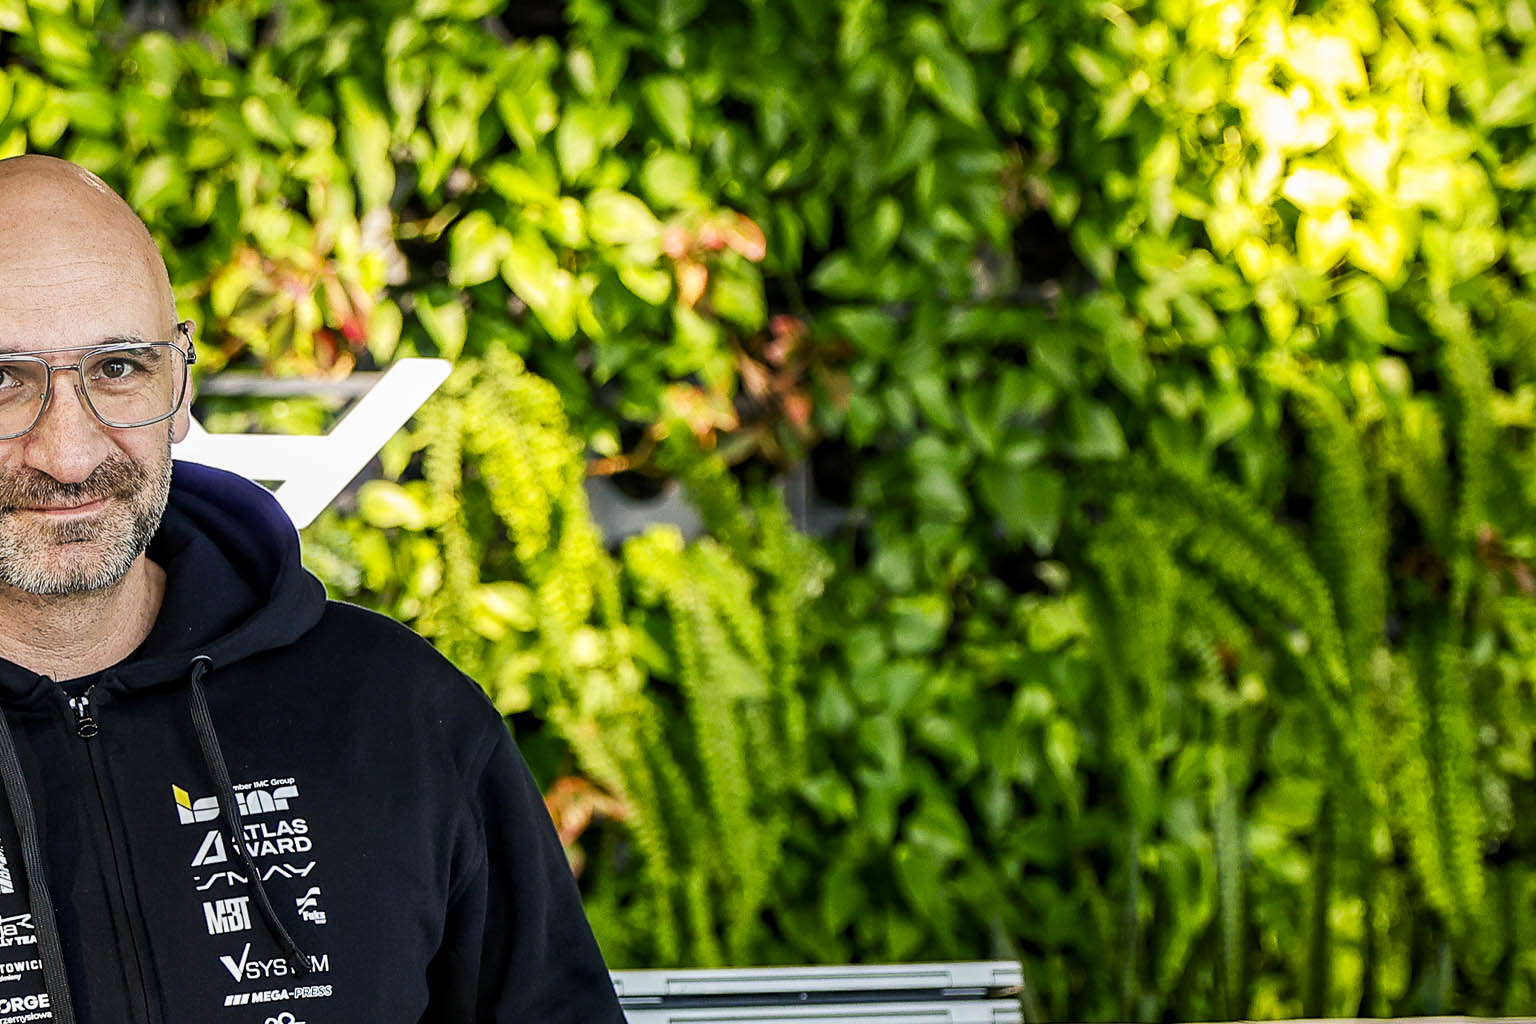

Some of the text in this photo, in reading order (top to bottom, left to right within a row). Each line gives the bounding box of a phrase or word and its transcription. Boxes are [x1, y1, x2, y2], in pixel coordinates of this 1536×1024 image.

[253, 779, 269, 788] IMC
[270, 777, 295, 786] Group
[14, 935, 37, 946] TEA
[251, 985, 333, 1004] MEGA-PRESS
